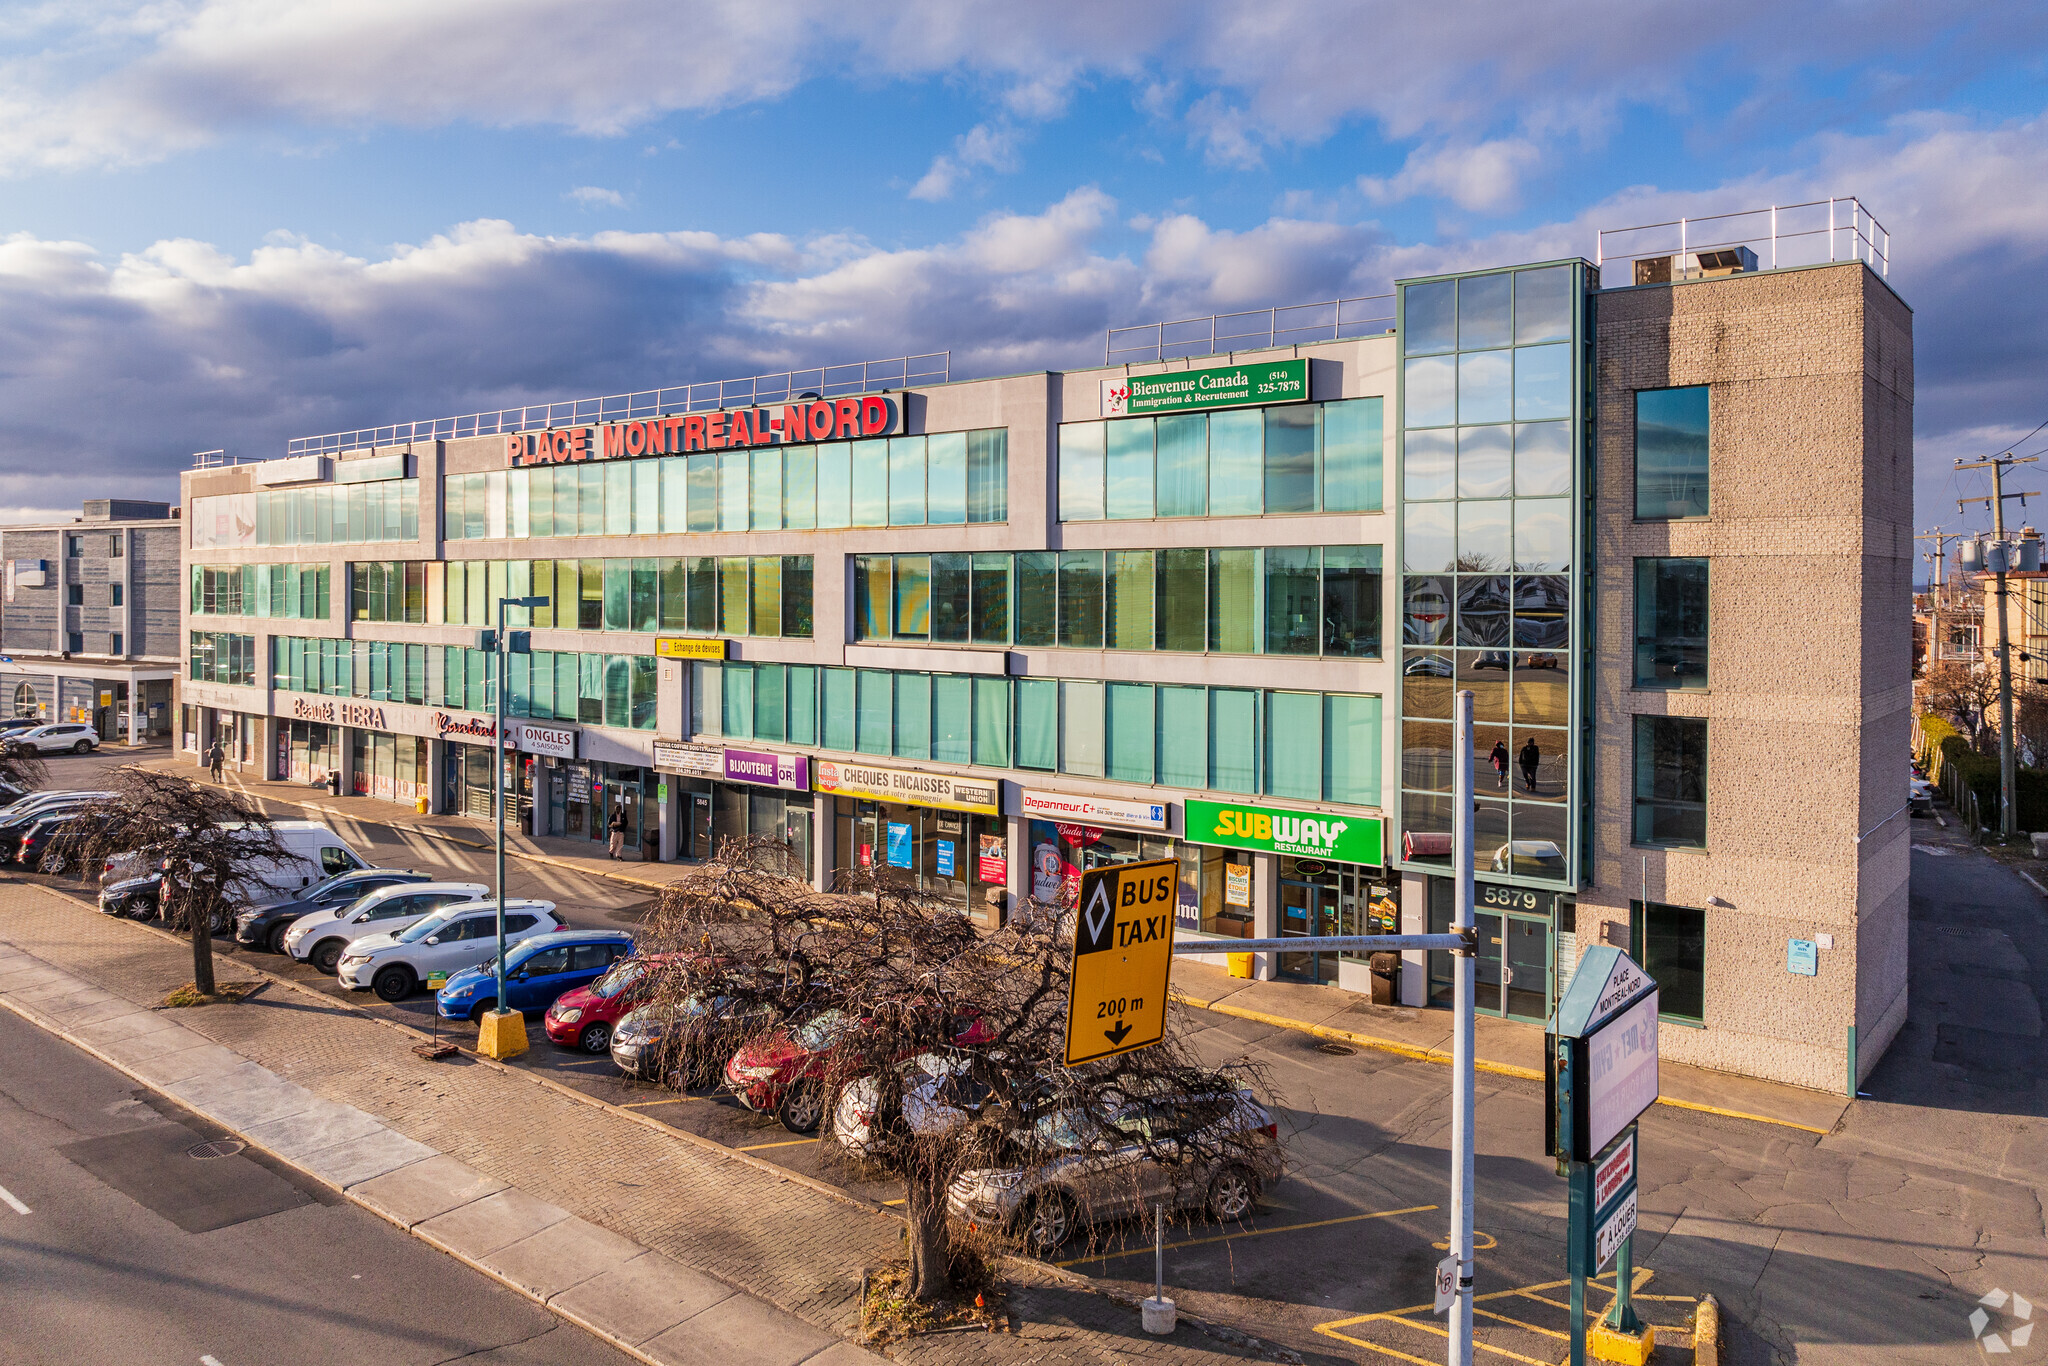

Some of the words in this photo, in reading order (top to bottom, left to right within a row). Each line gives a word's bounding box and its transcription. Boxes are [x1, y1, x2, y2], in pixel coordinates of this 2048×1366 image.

[1132, 379, 1195, 397] Bienvenue
[1199, 371, 1249, 390] Canada
[1269, 370, 1288, 381] (514)
[1257, 380, 1301, 395] 325-7878
[1132, 395, 1182, 408] Immigration
[1184, 394, 1192, 402] &
[1195, 389, 1249, 402] Recrutement
[507, 428, 590, 467] PLACE
[603, 396, 889, 459] MONTREAL-NORD
[695, 643, 701, 652] de
[340, 704, 387, 729] HERA
[525, 728, 571, 745] ONGLES
[537, 742, 564, 751] SAISONS
[729, 759, 773, 777] BIJOUTERIE
[779, 770, 796, 781] OR!
[818, 765, 839, 777] Insta
[844, 768, 889, 787] CHEQUES
[893, 774, 951, 795] ENCAISSES
[955, 786, 988, 796] WESTERN
[852, 786, 866, 794] pour
[883, 788, 890, 796] et
[891, 790, 906, 798] votre
[908, 791, 943, 804] compagnie
[965, 795, 988, 804] UNION
[1213, 810, 1348, 848] SUBWAY
[1274, 842, 1333, 857] RESTAURANT
[1121, 876, 1170, 907] BUS
[1484, 886, 1537, 909] 5879
[1117, 915, 1167, 947] TAXI
[1613, 968, 1630, 988] PLACE
[1599, 976, 1642, 1014] MONTRÉAL-NORD
[1097, 998, 1127, 1019] 200
[1130, 997, 1144, 1012] m
[1596, 1142, 1632, 1188] STATIONNEMENT
[1607, 1226, 1613, 1246] À
[1614, 1203, 1636, 1236] LOUER
